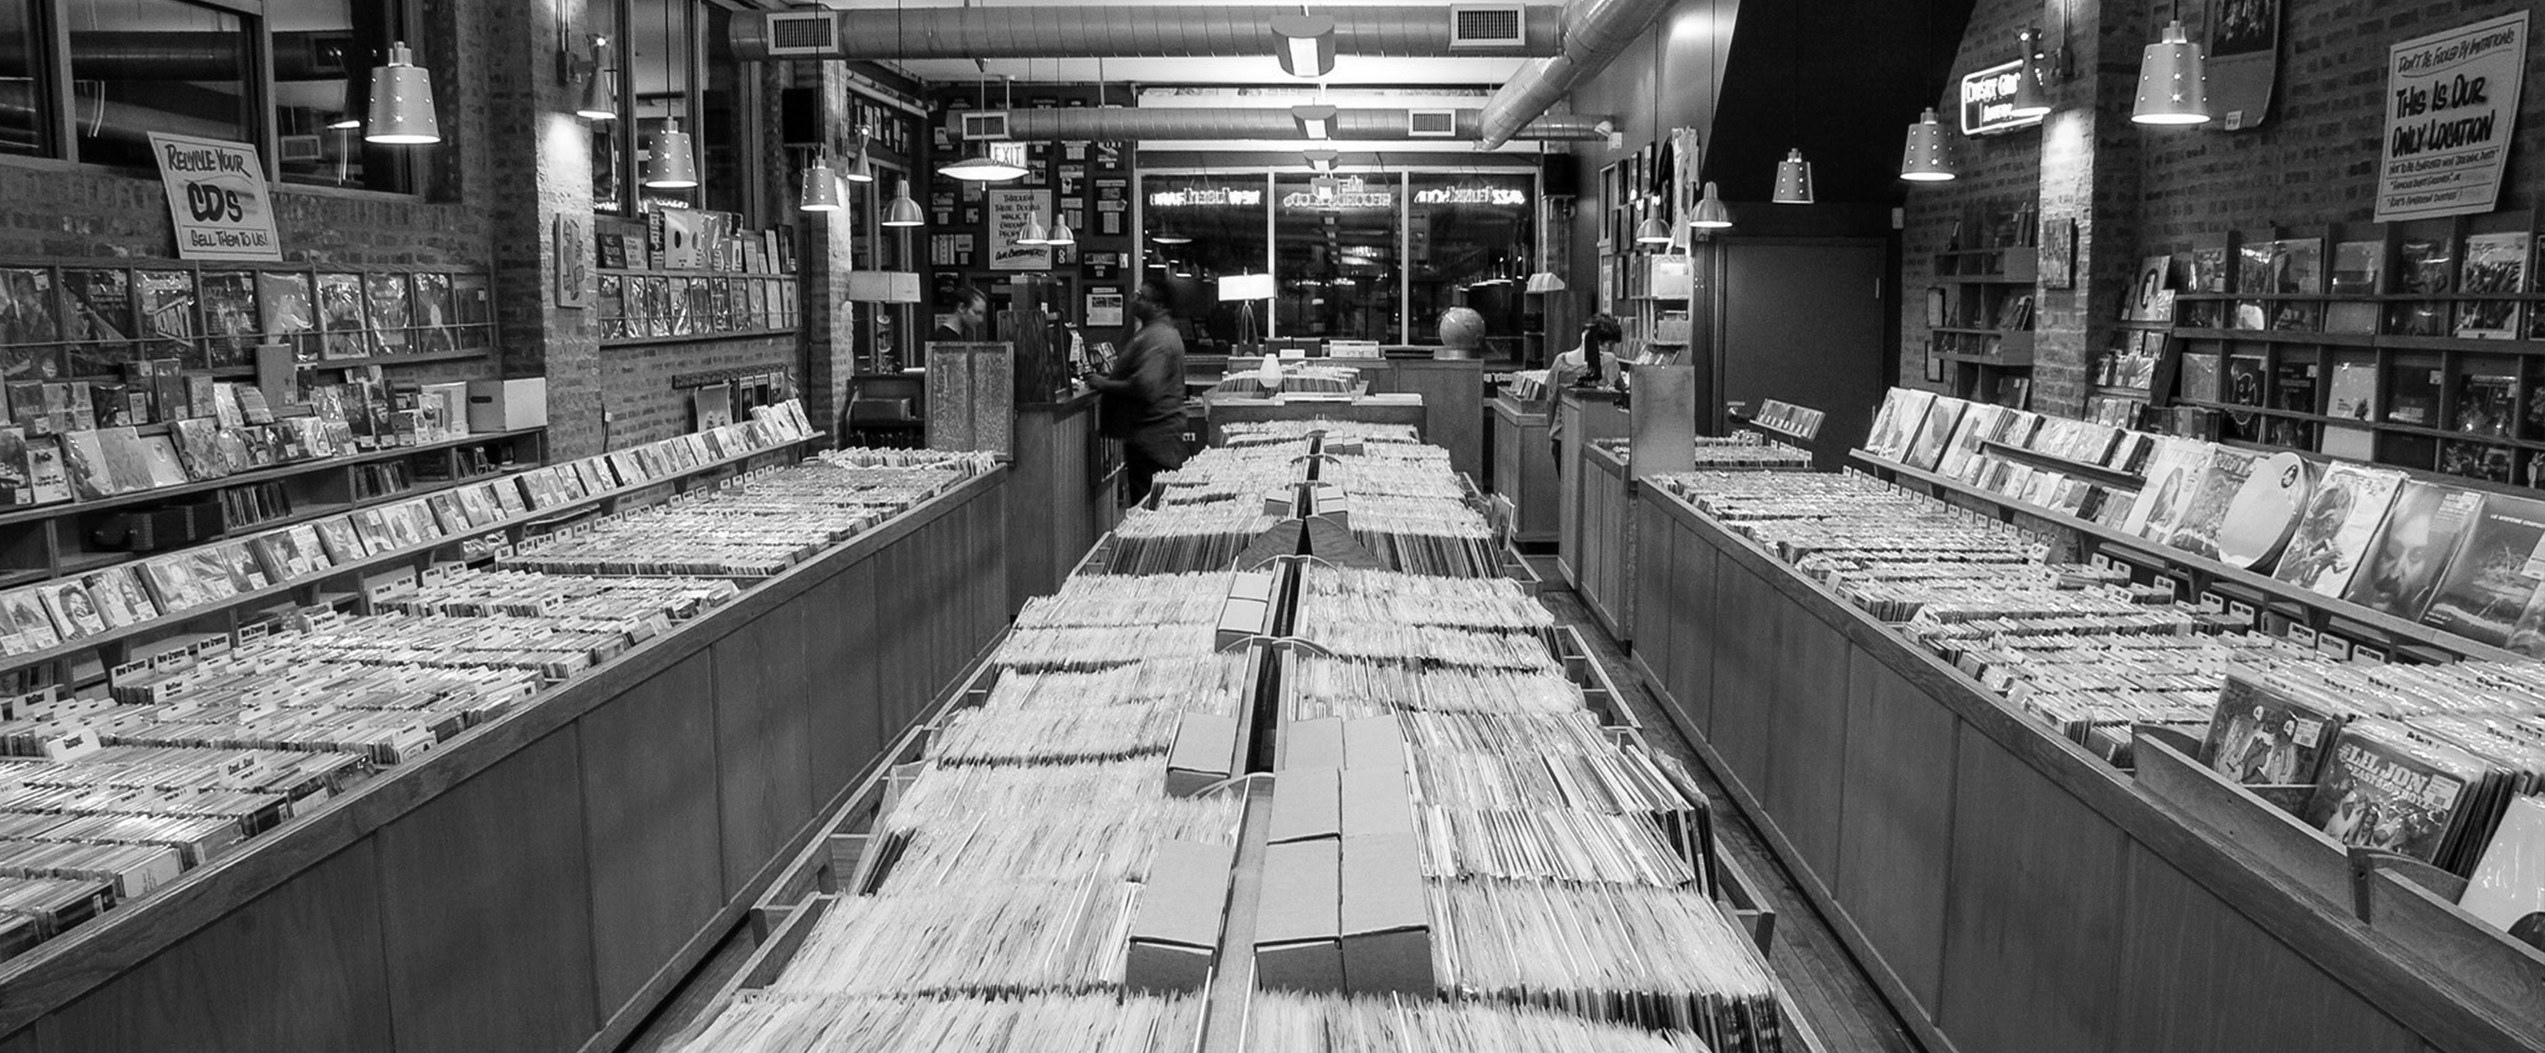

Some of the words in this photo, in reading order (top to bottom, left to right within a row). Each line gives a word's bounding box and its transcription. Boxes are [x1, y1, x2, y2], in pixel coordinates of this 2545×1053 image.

[2421, 49, 2433, 69] BE
[2458, 41, 2471, 60] BY
[2396, 86, 2427, 119] THIS
[2431, 80, 2448, 112] IS
[2451, 73, 2487, 109] OUR
[2391, 123, 2428, 158] ONLY
[2428, 109, 2496, 150] LOCATION
[164, 143, 217, 172] RECYCLE
[214, 148, 253, 179] YOUR
[995, 146, 1022, 166] EXIT
[191, 228, 217, 247] SELL
[215, 230, 241, 248] THEM
[239, 231, 251, 247] TO
[250, 231, 268, 247] US!
[2348, 745, 2380, 775] LIL
[2380, 761, 2429, 795] JON
